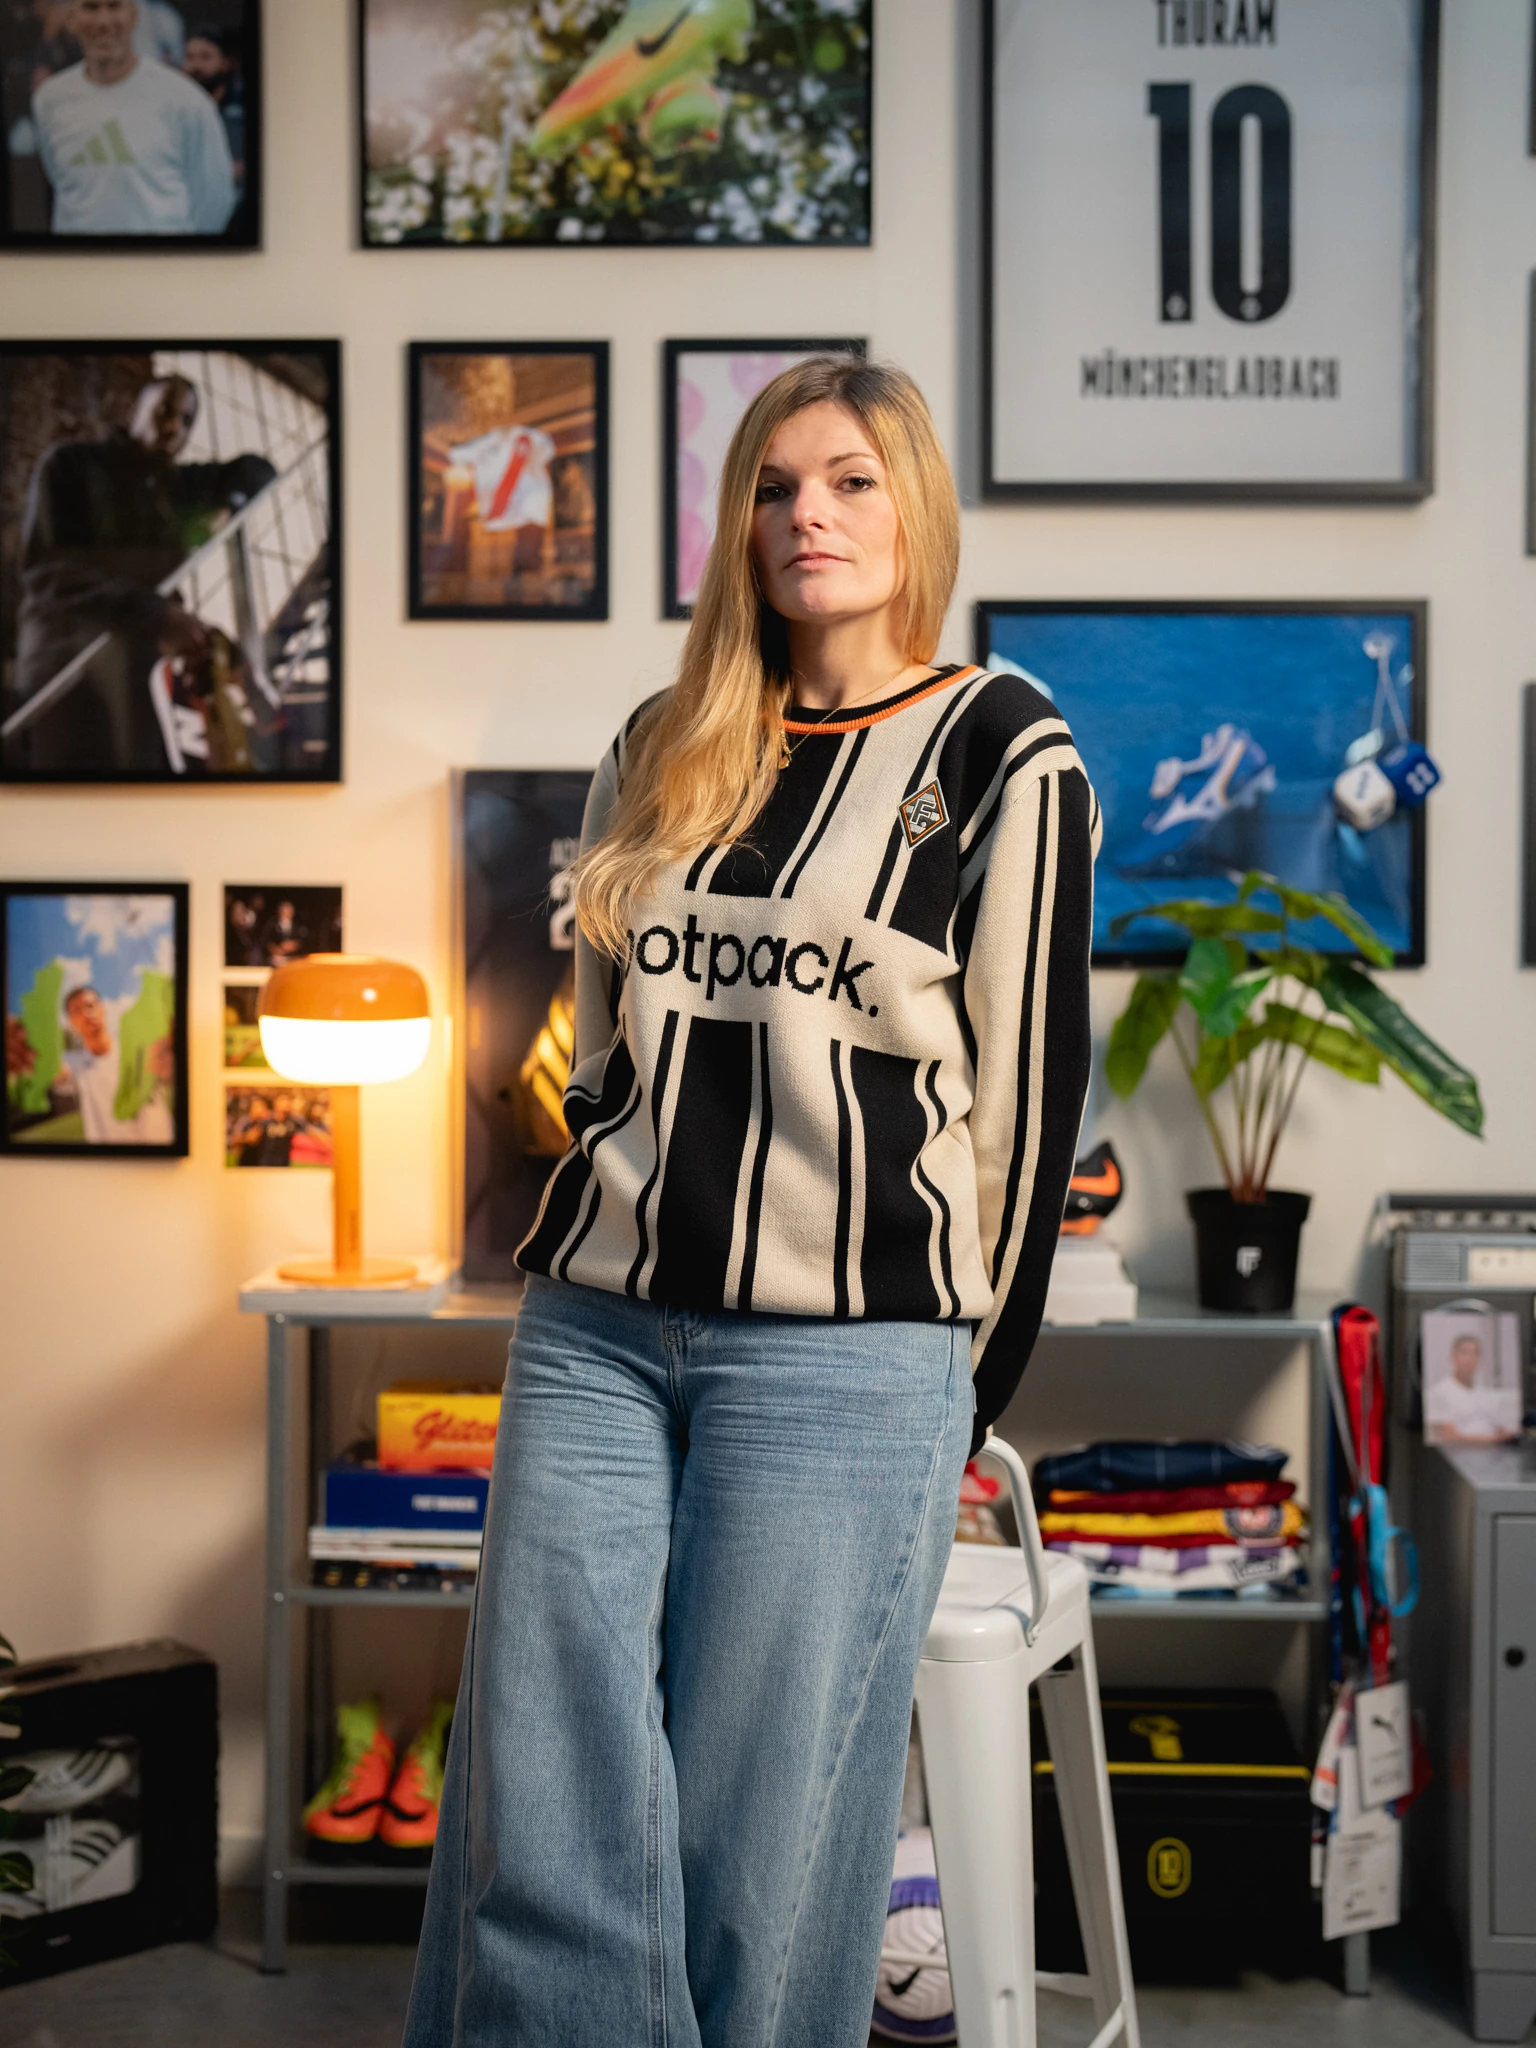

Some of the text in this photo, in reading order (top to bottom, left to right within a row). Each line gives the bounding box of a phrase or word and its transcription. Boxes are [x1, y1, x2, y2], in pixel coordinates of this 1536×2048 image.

[1156, 0, 1277, 46] THURAM
[1146, 81, 1293, 323] 10
[626, 914, 879, 1017] otpack.
